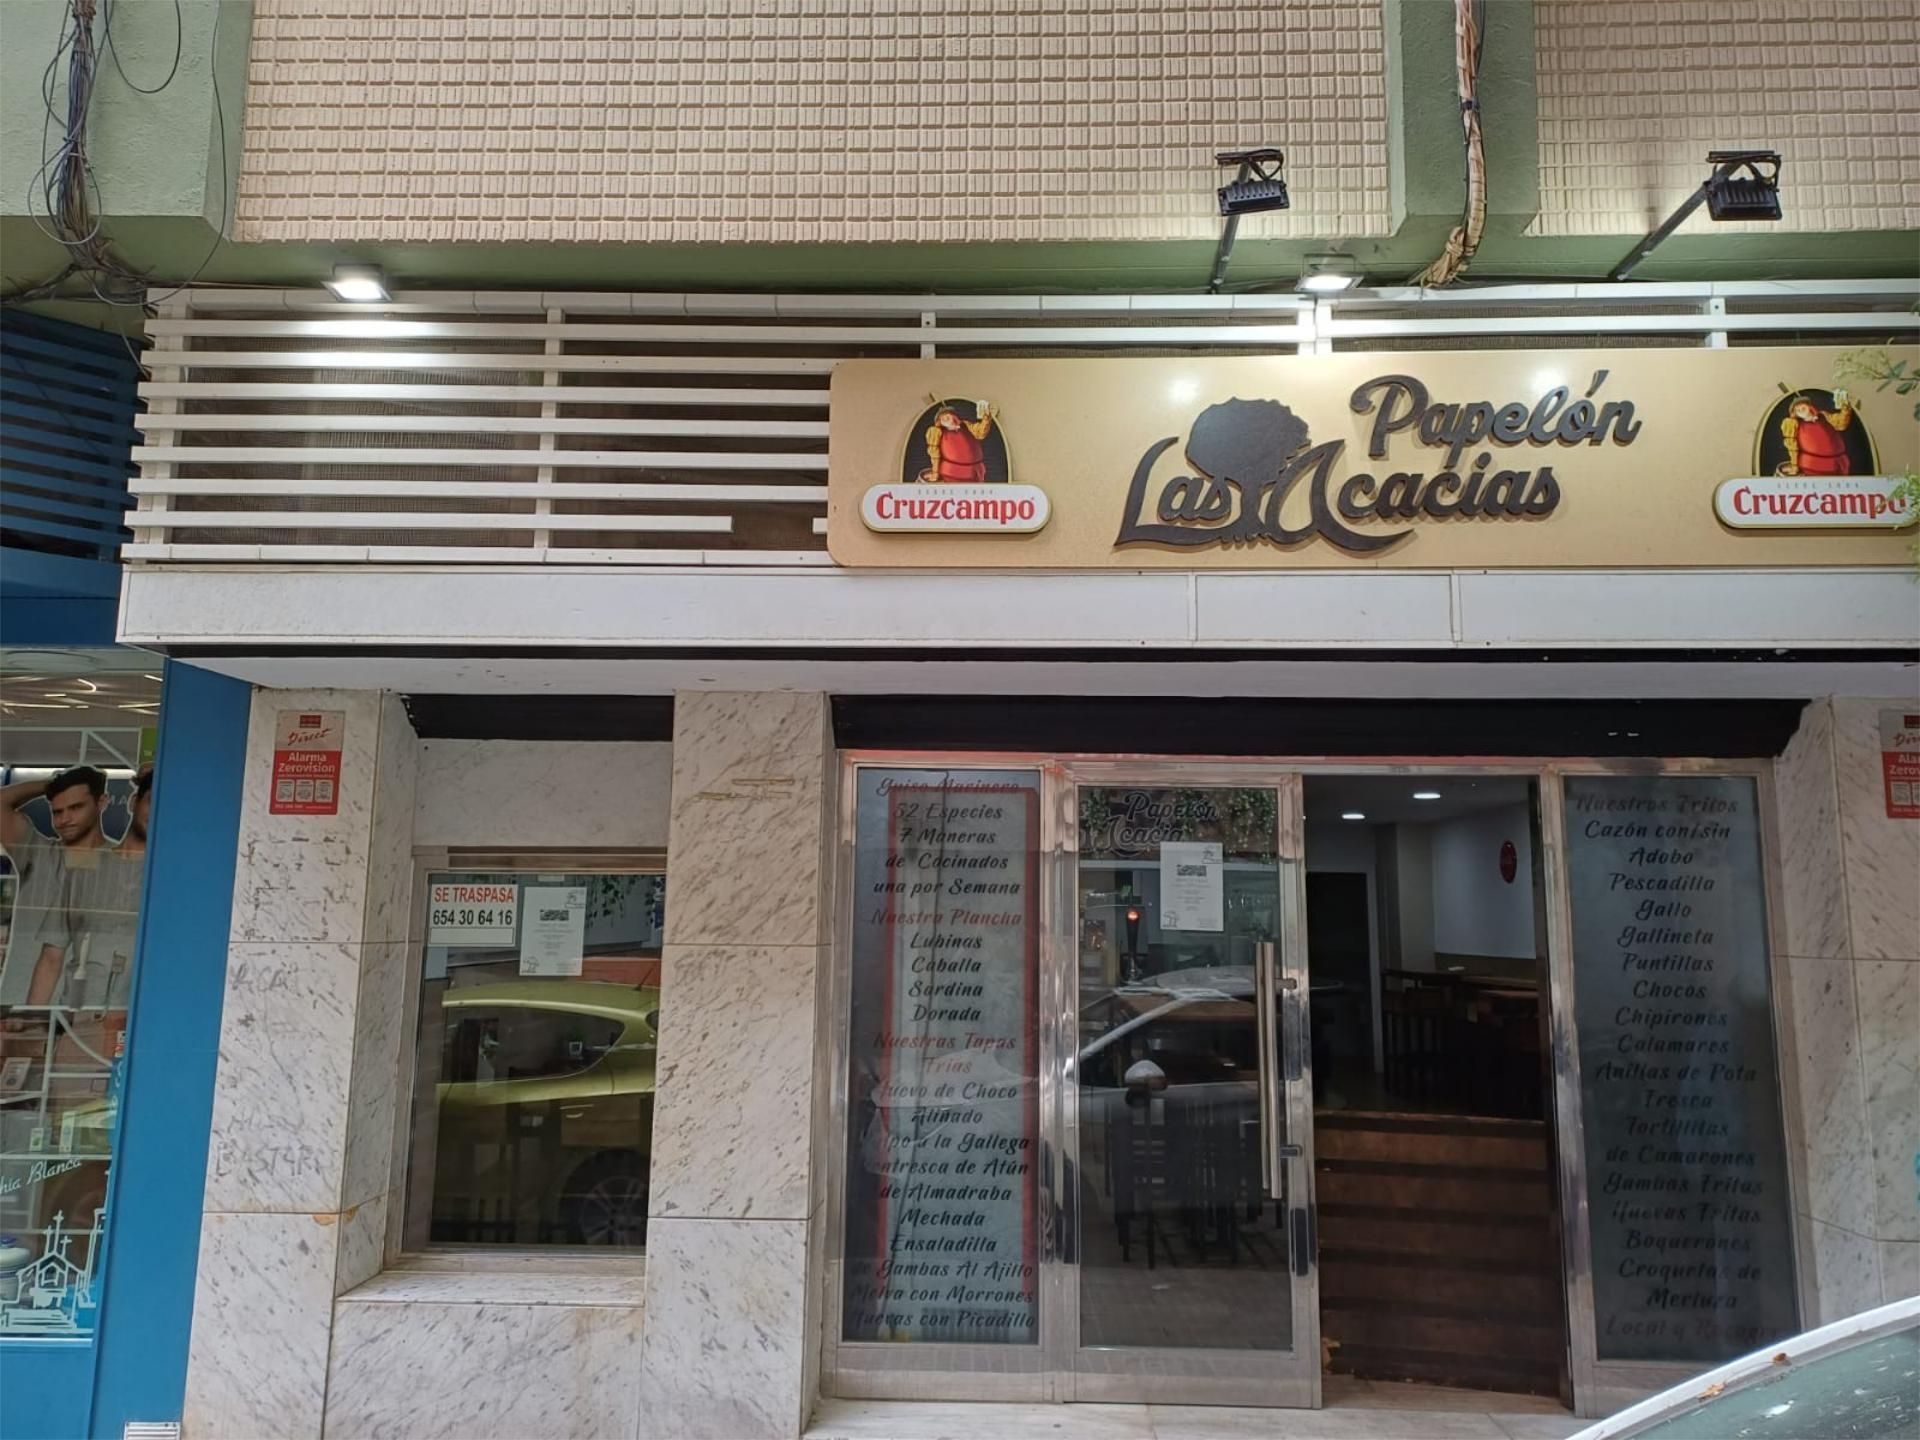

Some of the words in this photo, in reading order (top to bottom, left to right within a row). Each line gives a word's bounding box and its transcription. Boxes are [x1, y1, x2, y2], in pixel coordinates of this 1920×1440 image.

[1349, 369, 1642, 468] Papelón
[1114, 436, 1242, 548] Las
[1264, 438, 1562, 552] Acacias
[1733, 486, 1906, 519] Cruzcampo
[876, 492, 1035, 525] Cruzcampo
[288, 752, 326, 762] Alarma
[278, 762, 336, 773] Zerovision
[926, 802, 1003, 822] Especies
[900, 828, 912, 842] 7
[916, 827, 997, 845] Maneras
[1103, 815, 1185, 857] Acacia
[1585, 820, 1648, 839] Cazón
[885, 854, 906, 869] de
[918, 852, 1009, 870] Cocinados
[1628, 847, 1694, 866] Adobo
[873, 881, 906, 895] una
[910, 882, 944, 898] por
[948, 878, 1021, 896] Semana
[1609, 872, 1716, 891] Pescadilla
[434, 887, 449, 902] SE
[453, 887, 514, 903] TRASPASA
[433, 910, 454, 925] 654
[459, 910, 474, 925] 30
[478, 910, 493, 925] 64
[498, 910, 512, 925] 16
[871, 908, 944, 925] Nuestra
[950, 908, 1023, 926] Plancha
[1635, 899, 1693, 921] Gallo
[910, 932, 983, 949] Lubinas
[1617, 926, 1715, 948] Gallineta
[911, 956, 982, 974] Caballa
[1622, 952, 1715, 973] Puntillas
[908, 980, 984, 998] Sardina
[1633, 979, 1708, 999] Chocos
[911, 1003, 982, 1022] Dorada
[1615, 1005, 1728, 1030] Chipirones
[873, 1031, 956, 1049] Nuestras
[964, 1031, 1017, 1053] Tapas
[1617, 1033, 1730, 1054] Calamares
[1678, 1063, 1700, 1080] de
[1709, 1063, 1758, 1083] Pota
[934, 1082, 955, 1098] de
[961, 1081, 1018, 1100] Choco
[934, 1134, 952, 1149] la
[957, 1133, 1031, 1155] Gallega
[1606, 1146, 1630, 1163] de
[1638, 1146, 1756, 1166] Camarones
[27, 1158, 82, 1185] Blanca
[880, 1158, 949, 1175] ntresca
[954, 1159, 976, 1175] de
[983, 1158, 1029, 1178] Atún
[879, 1185, 902, 1200] de
[907, 1183, 1012, 1202] Almadraba
[1603, 1172, 1690, 1194] Gambas
[900, 1208, 986, 1227] Mechada
[890, 1234, 998, 1252] Ensaladilla
[876, 1259, 950, 1280] Gambas
[955, 1261, 978, 1280] Al
[983, 1261, 1033, 1282] Ajillo
[909, 1288, 940, 1301] con
[946, 1285, 1034, 1304] Morrones
[919, 1311, 950, 1326] con
[957, 1310, 1036, 1329] Picadillo
